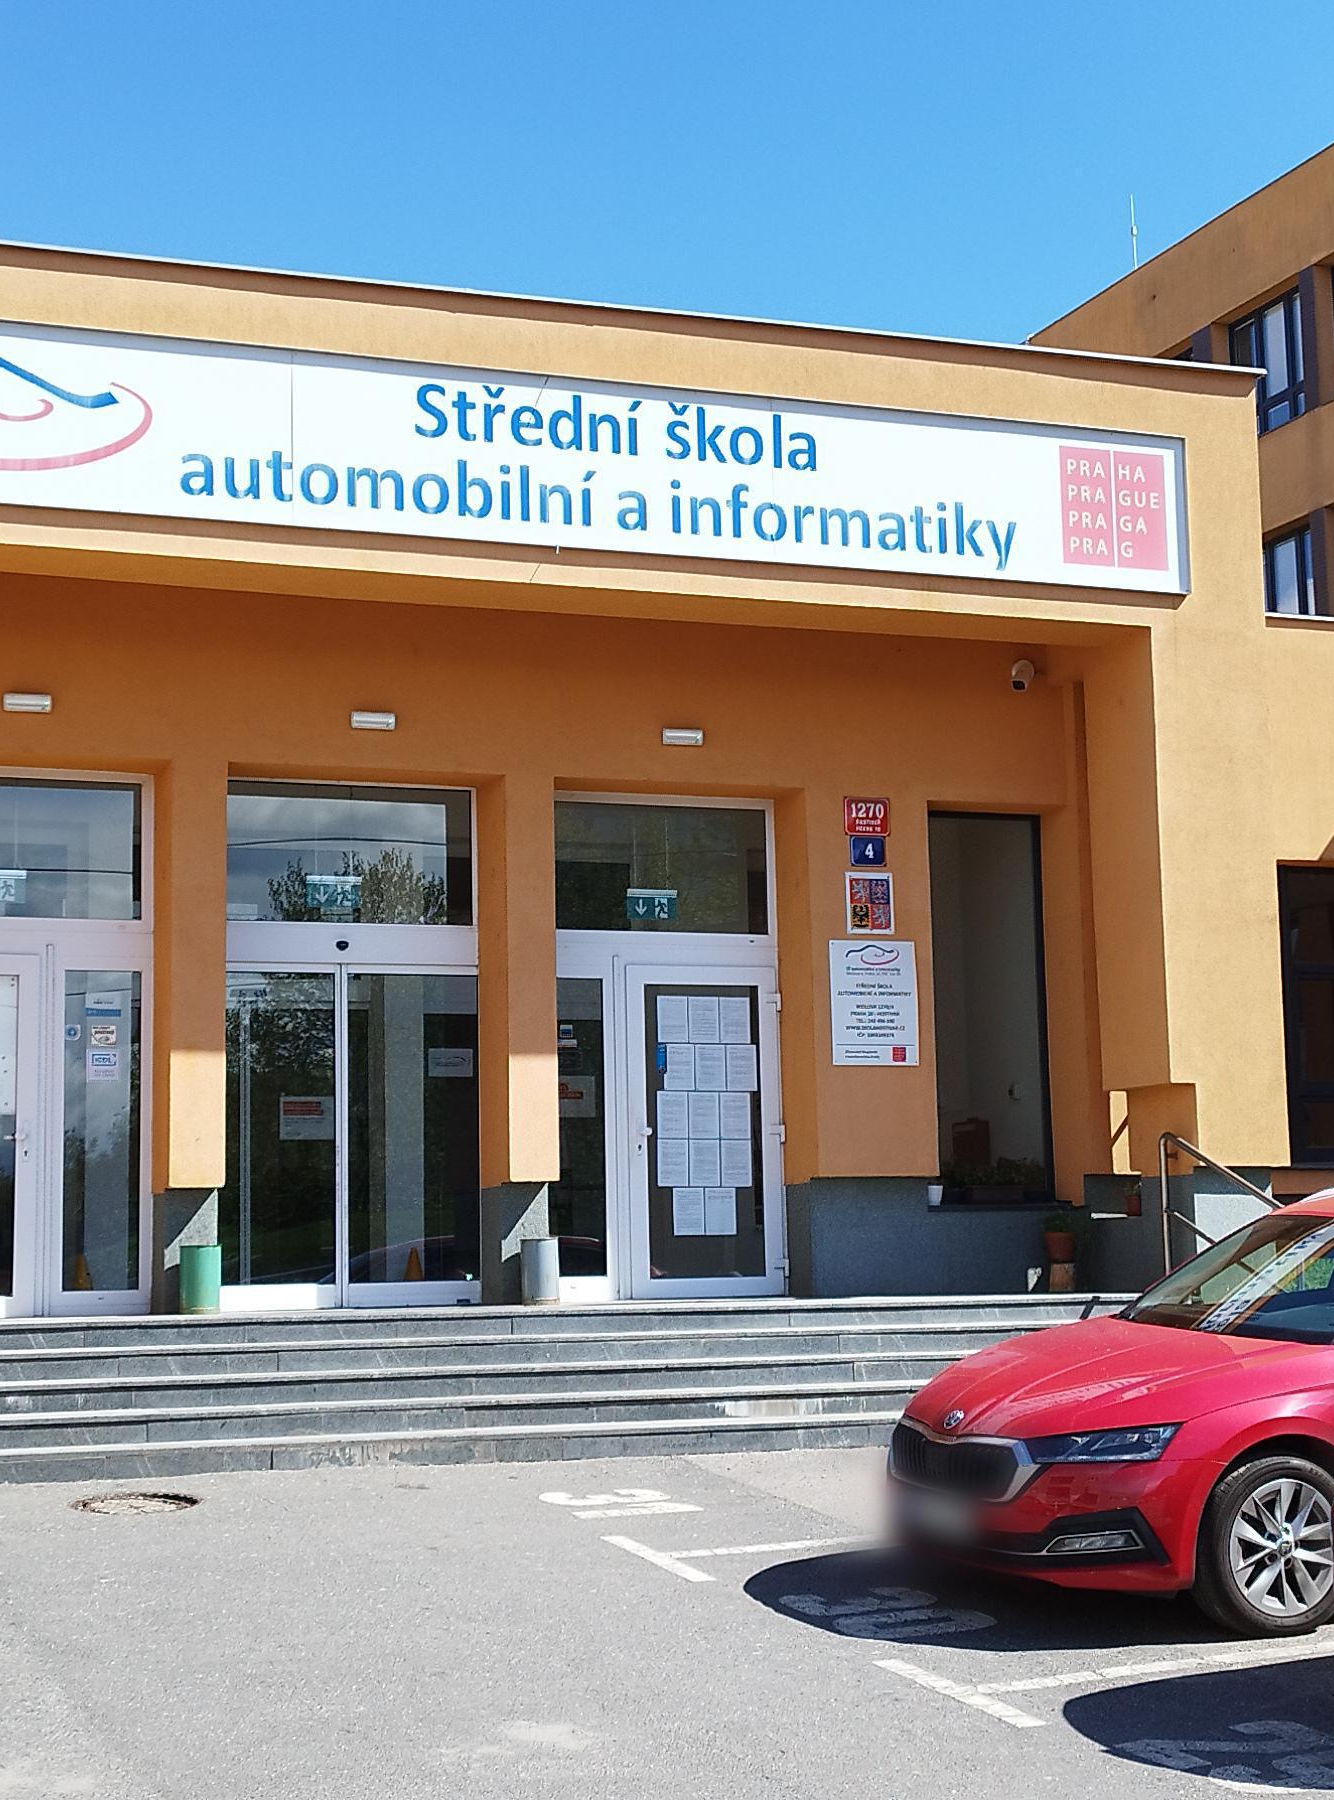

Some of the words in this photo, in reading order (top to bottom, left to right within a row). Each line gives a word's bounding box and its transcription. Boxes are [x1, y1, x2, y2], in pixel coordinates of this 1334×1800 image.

[415, 384, 642, 455] Střední
[666, 401, 817, 472] škola
[1066, 459, 1106, 479] PRA
[1118, 464, 1146, 483] HA
[1067, 484, 1107, 504] PRA
[1118, 490, 1160, 509] GUE
[179, 451, 597, 526] automobilní
[617, 490, 648, 531] a
[671, 480, 1017, 570] informatiky
[1068, 510, 1108, 530] PRA
[1119, 516, 1148, 535] GA
[1069, 537, 1109, 556] PRA
[1120, 541, 1134, 558] G
[850, 803, 884, 818] 1270
[864, 843, 874, 859] 4
